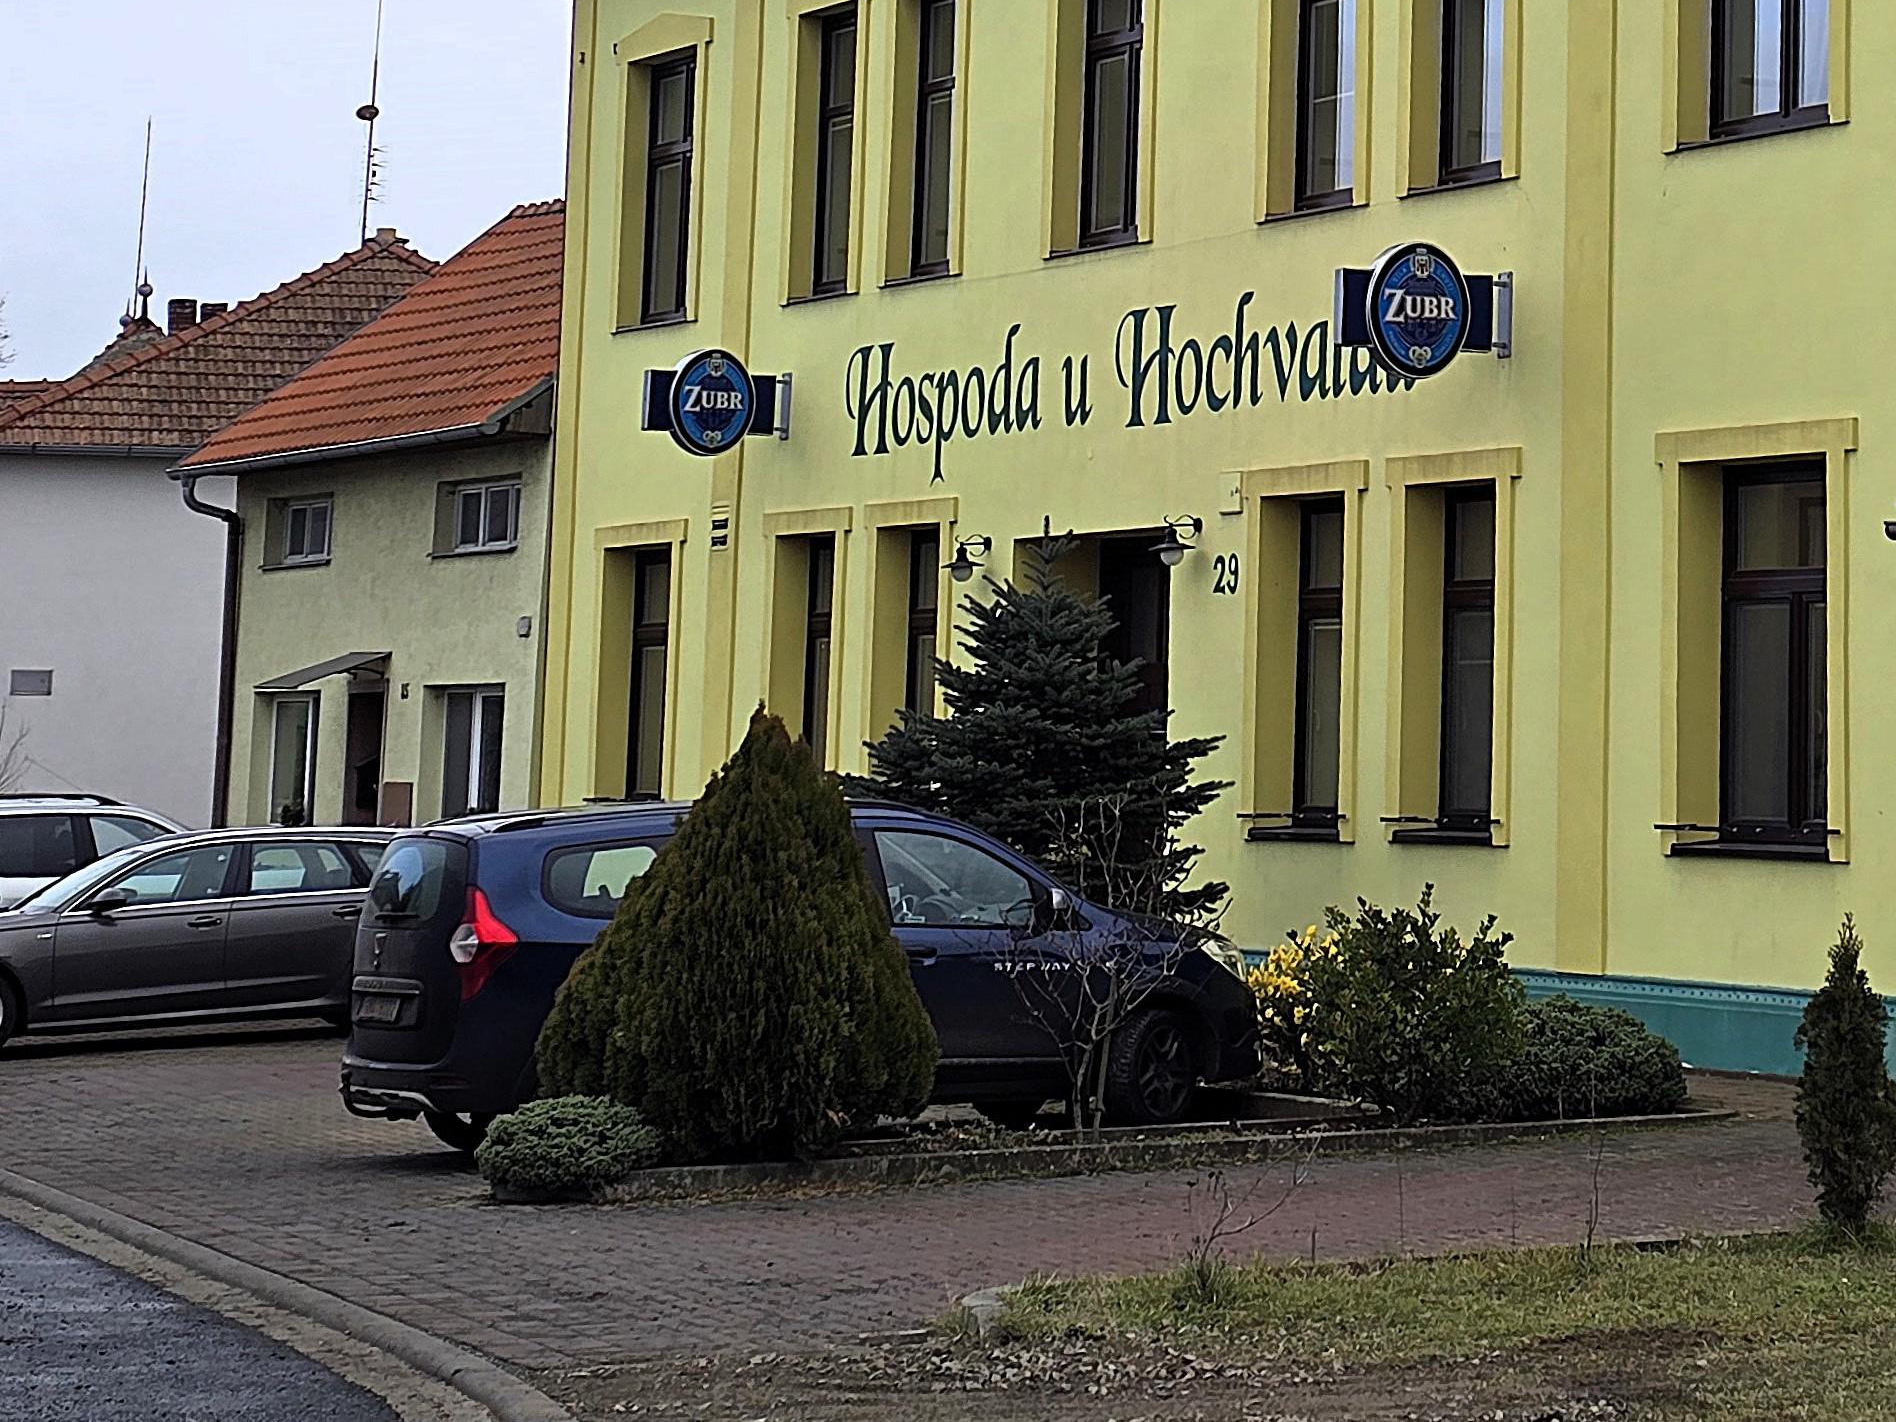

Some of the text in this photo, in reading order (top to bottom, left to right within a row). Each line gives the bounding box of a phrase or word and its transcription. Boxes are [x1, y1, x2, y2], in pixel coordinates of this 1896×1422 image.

[1383, 288, 1458, 323] ZUBR
[683, 385, 744, 412] ZUBR
[846, 291, 1416, 486] Hospoda u Hochva
[1213, 552, 1240, 595] 29
